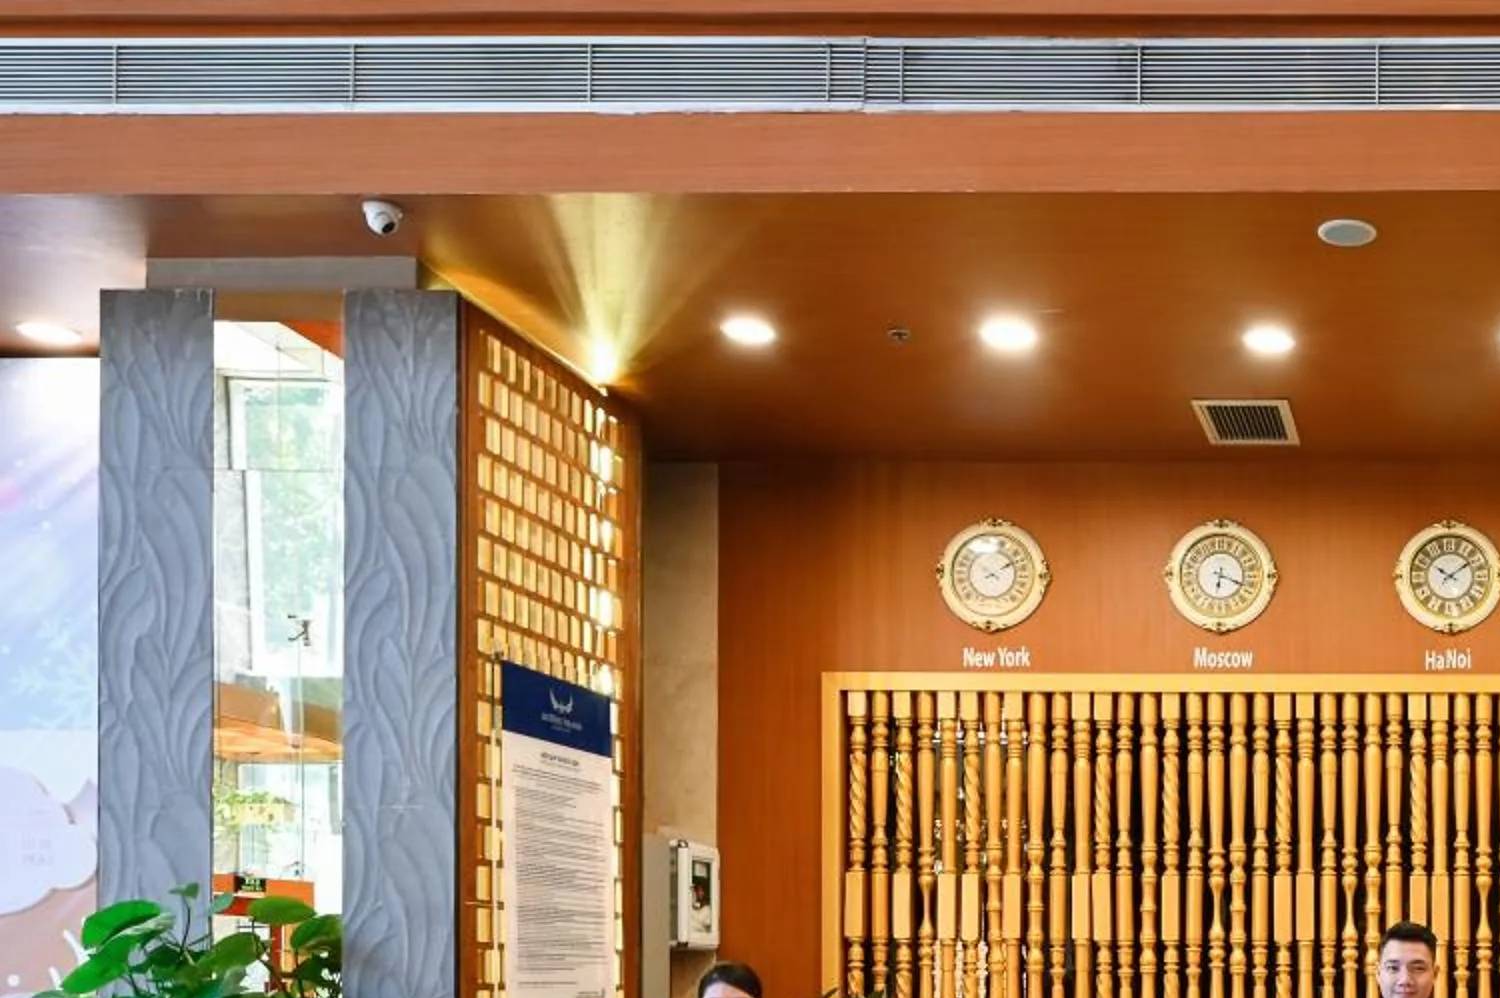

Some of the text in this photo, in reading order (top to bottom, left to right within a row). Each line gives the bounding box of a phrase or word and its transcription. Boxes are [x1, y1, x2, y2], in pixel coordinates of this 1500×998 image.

[962, 646, 1031, 668] New York
[1194, 647, 1253, 668] Moscow
